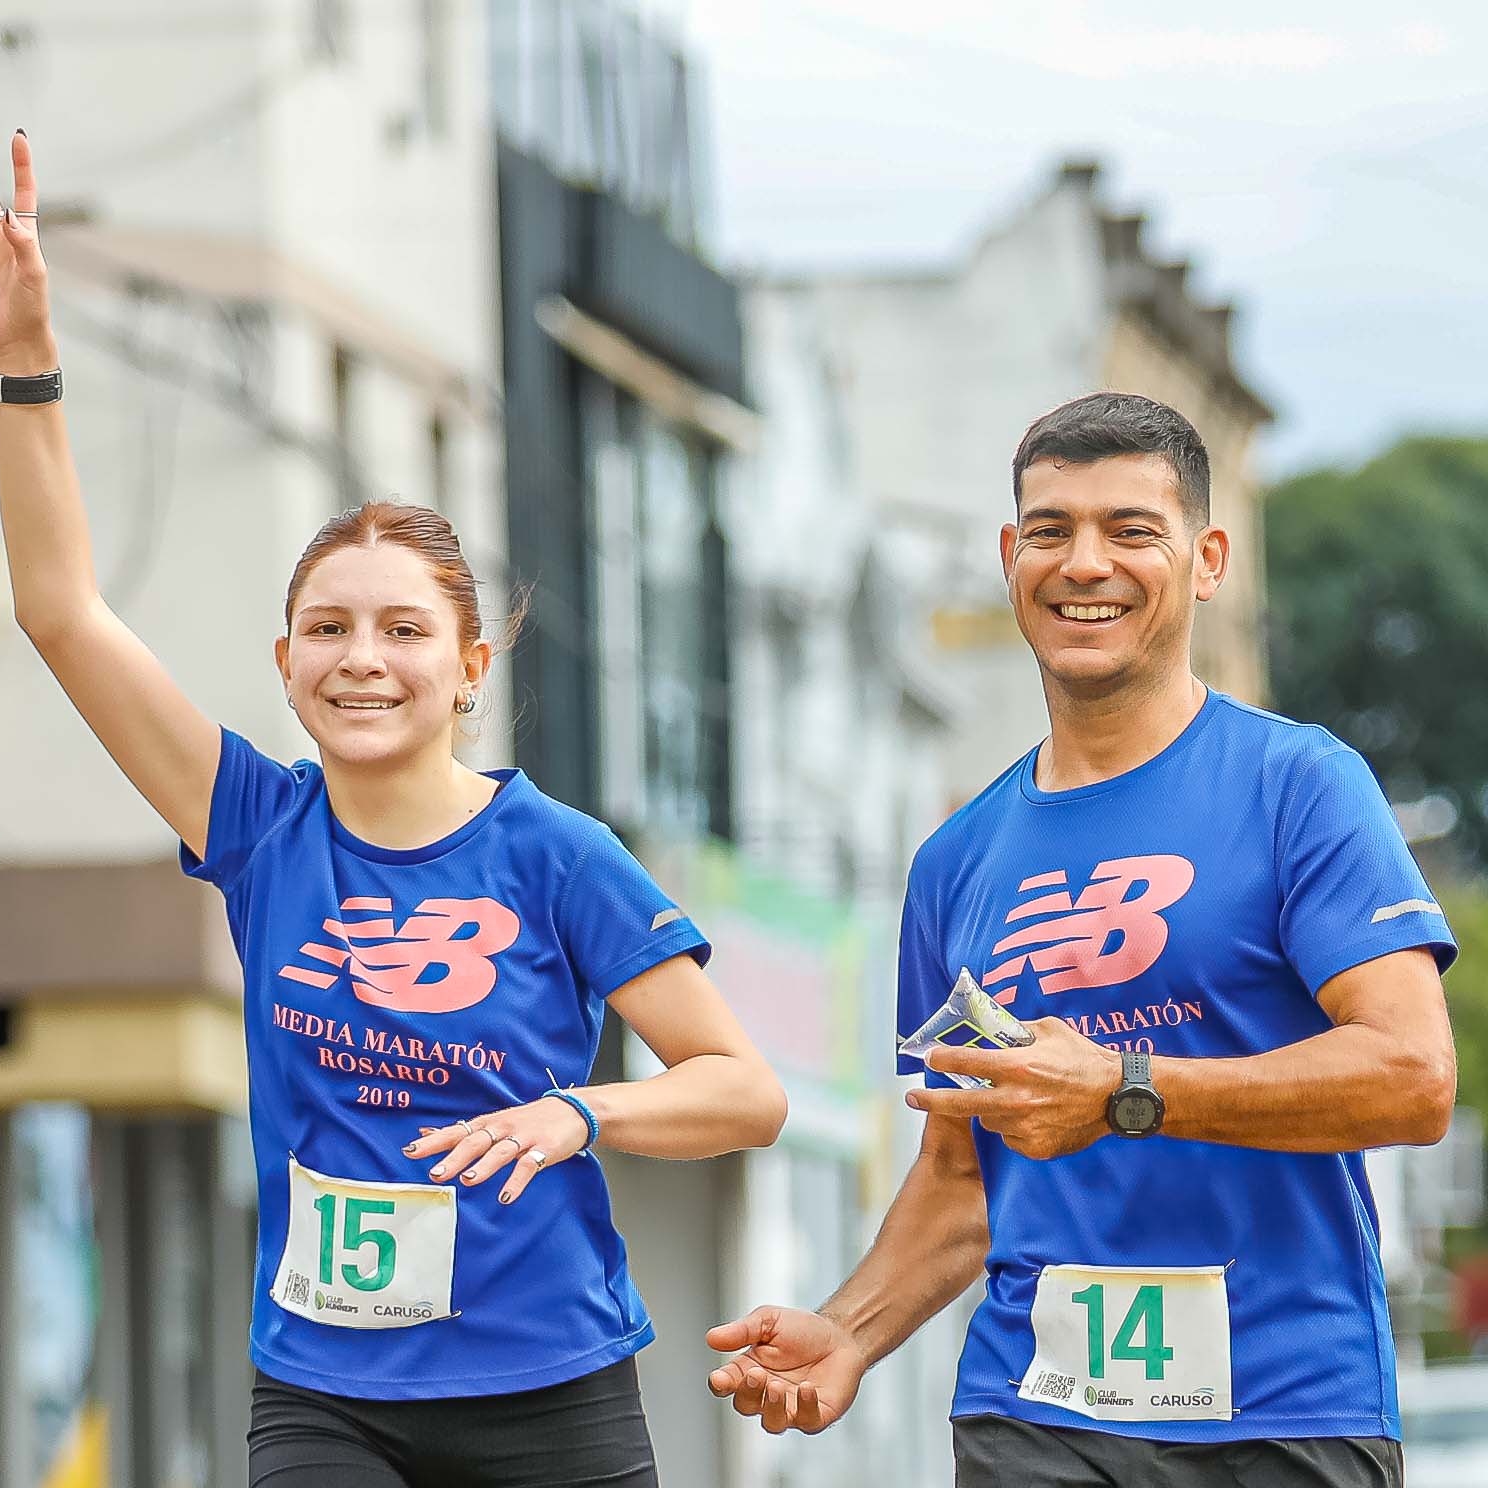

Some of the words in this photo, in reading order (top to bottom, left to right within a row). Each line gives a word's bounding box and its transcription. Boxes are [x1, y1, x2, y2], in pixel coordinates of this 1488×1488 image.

[1064, 997, 1202, 1037] MARATÓN
[273, 1003, 355, 1047] MEDIA
[363, 1027, 507, 1072] MARATÓN
[318, 1047, 450, 1085] ROSARIO
[357, 1085, 410, 1108] 2019
[314, 1193, 397, 1292] 15
[373, 1305, 432, 1319] CARUSO
[1071, 1284, 1174, 1380] 14
[1150, 1395, 1213, 1407] CARUSO
